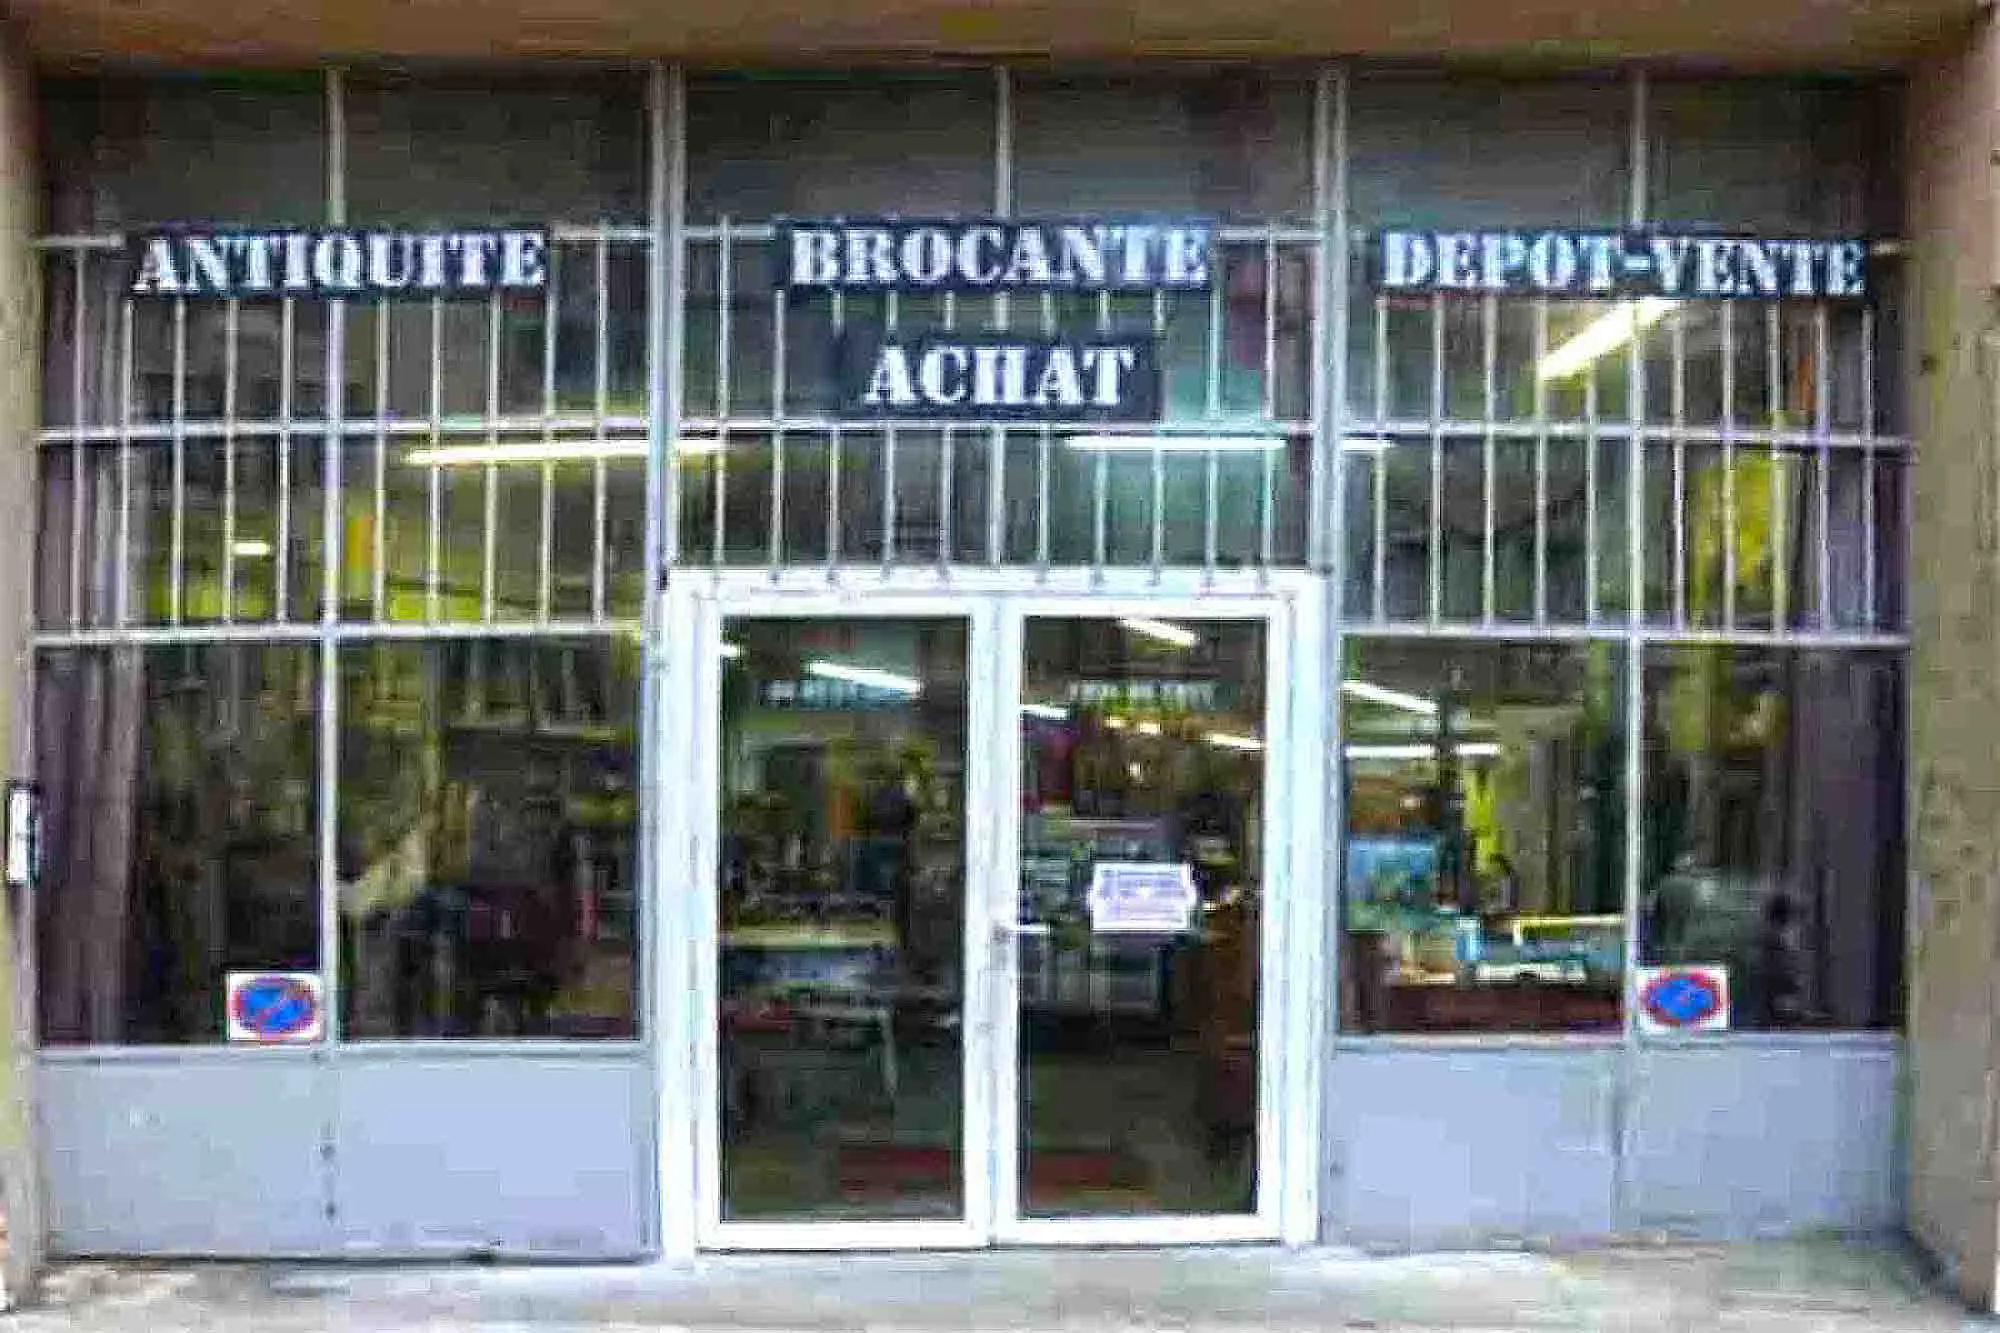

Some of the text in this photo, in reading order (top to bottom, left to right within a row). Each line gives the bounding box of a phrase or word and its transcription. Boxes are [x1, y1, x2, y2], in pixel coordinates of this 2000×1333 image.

[131, 231, 545, 292] ANTIQUITE
[789, 226, 1210, 285] BROCANTE
[1383, 232, 1865, 296] DEPOT-VENTE
[864, 345, 1137, 405] ACHAT
